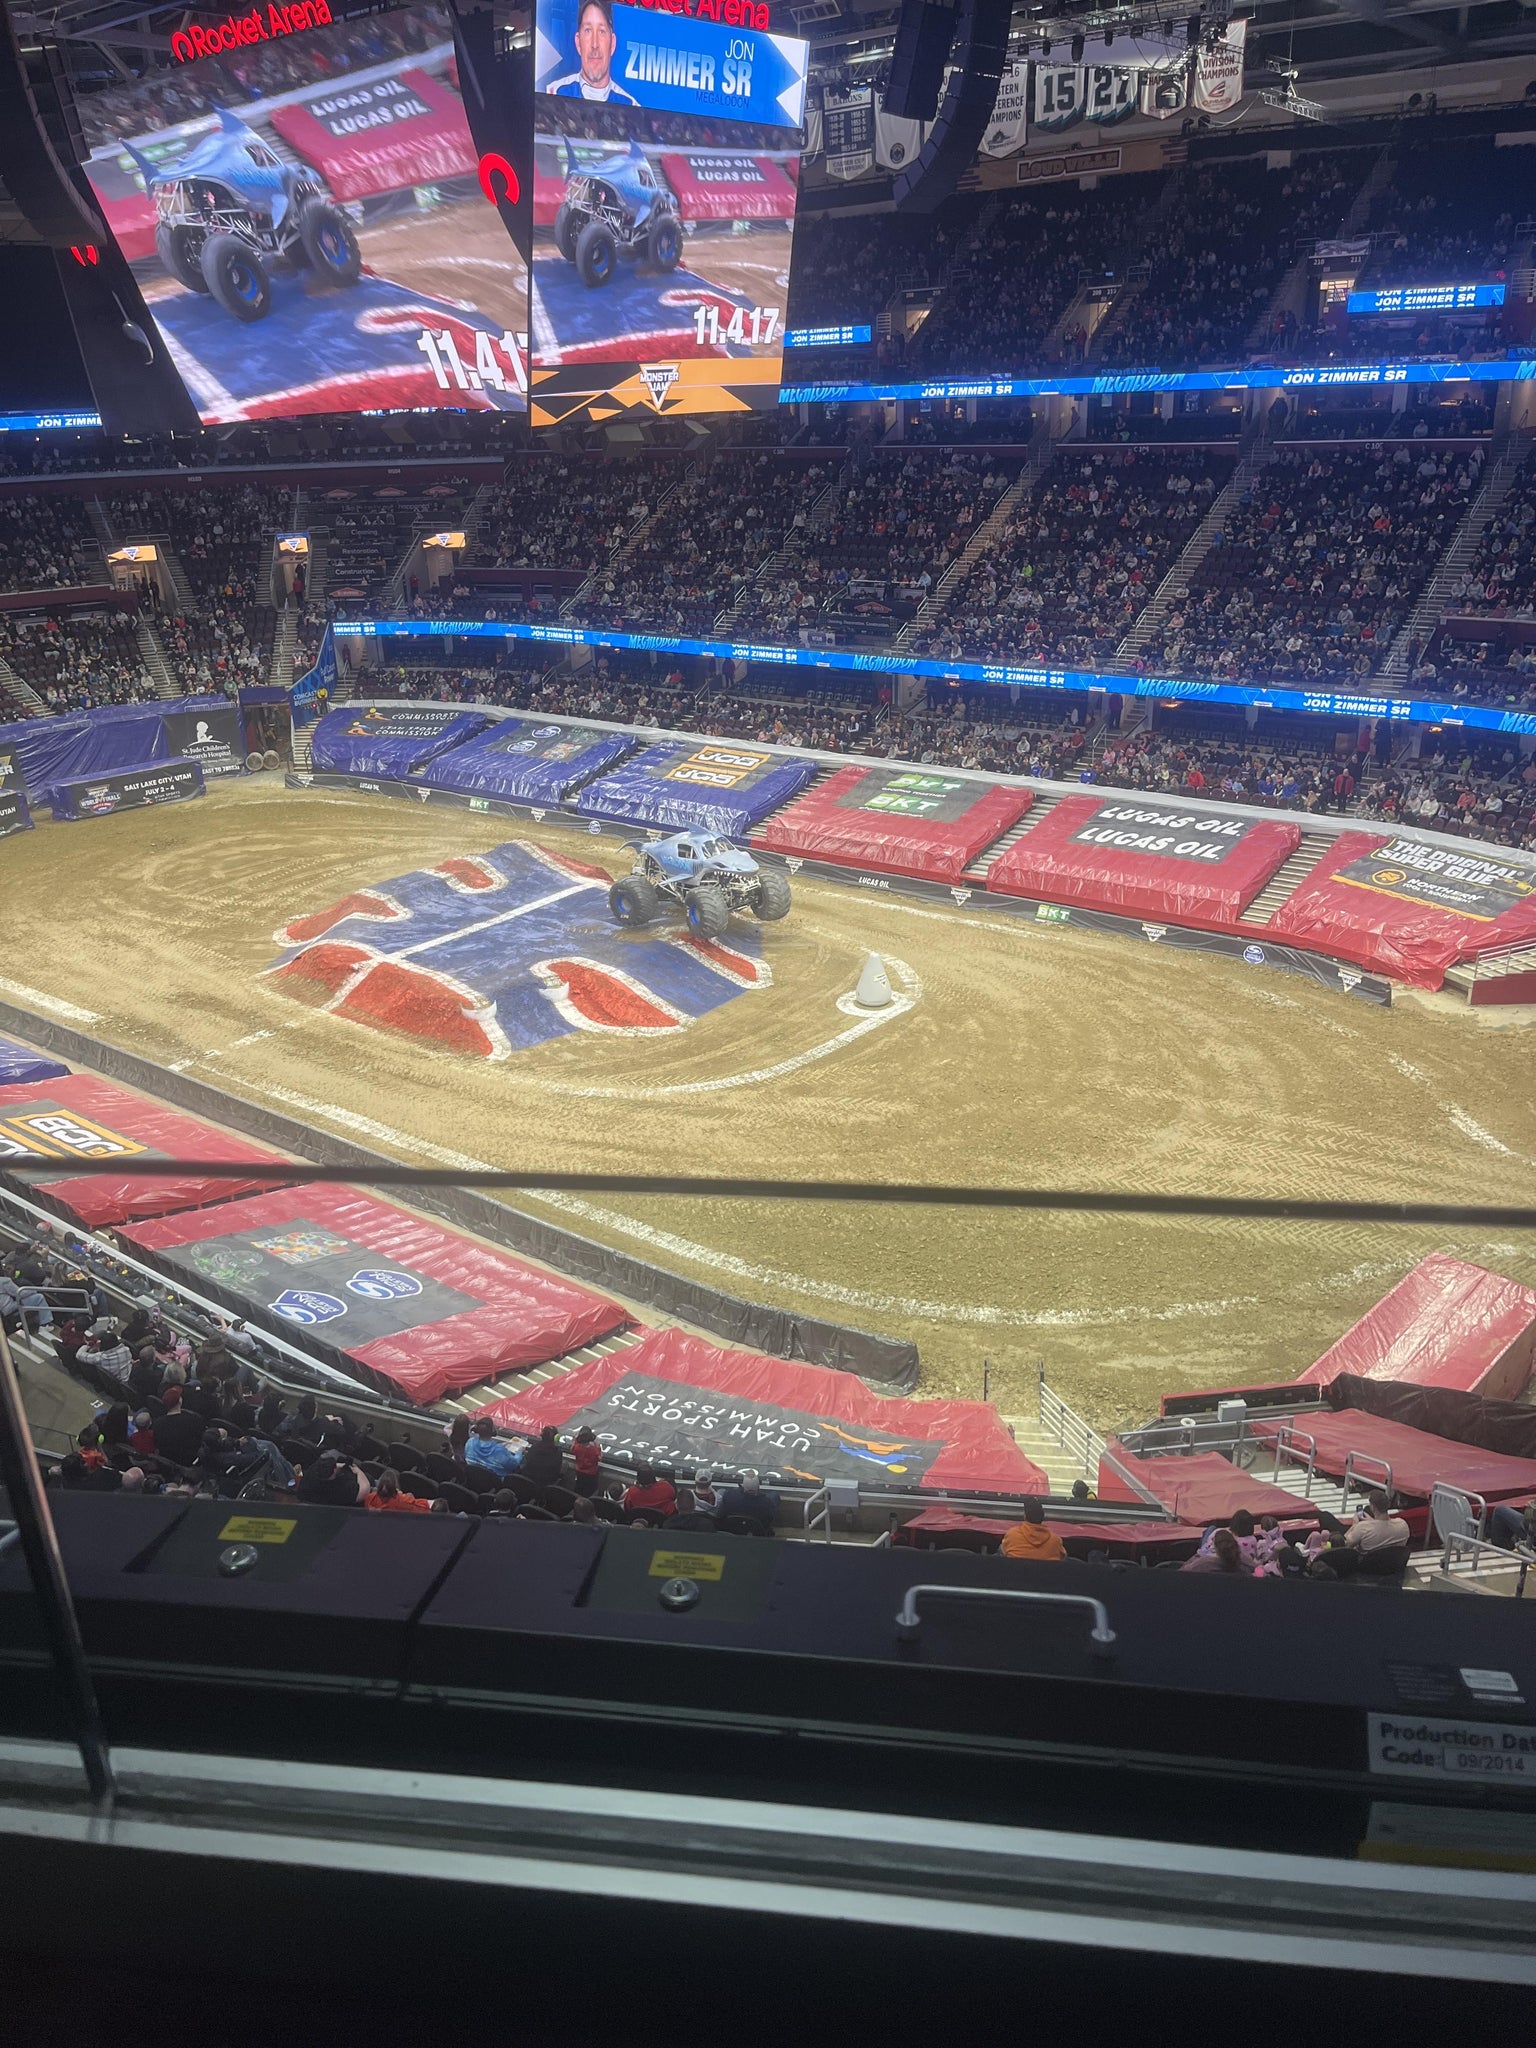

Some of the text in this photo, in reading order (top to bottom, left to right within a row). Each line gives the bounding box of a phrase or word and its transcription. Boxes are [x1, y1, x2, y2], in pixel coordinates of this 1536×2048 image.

[696, 0, 770, 31] Arena
[188, 0, 333, 58] Rocket Arena
[724, 38, 755, 62] JON
[624, 40, 753, 98] ZIMMER SR
[1203, 55, 1235, 68] DIVISION
[1197, 66, 1239, 80] CHAMPIONS
[695, 90, 750, 110] MEGALODON
[1043, 71, 1076, 114] 15
[310, 89, 373, 117] LUCAS
[329, 106, 394, 136] LUCAS
[990, 109, 1022, 124] AMPIONS
[689, 157, 732, 168] LUCAS
[696, 170, 745, 183] LUCAS
[1375, 293, 1476, 307] JON ZIMMER SR
[693, 306, 780, 345] 11.417
[791, 332, 853, 343] JON ZIMMER SR
[640, 371, 680, 384] MONSTER
[1282, 369, 1408, 385] JON ZIMMER SR
[649, 382, 670, 393] JAM
[921, 385, 1013, 397] JON ZIMMER SR
[36, 418, 62, 428] JON
[335, 568, 376, 576] Construction.
[333, 625, 376, 633] IMMER SR
[530, 630, 545, 638] JON
[545, 631, 573, 641] ZIMMER
[732, 649, 798, 661] JON ZIMMER SR
[982, 670, 1065, 685] JON ZIMMER SR
[1302, 698, 1411, 717] JON ZIMMER SR
[123, 784, 140, 792] SALT
[140, 780, 158, 789] LAKE
[174, 772, 192, 782] UTAH
[674, 769, 737, 785] JCB
[145, 788, 160, 796] JULY
[470, 798, 488, 809] BKT
[867, 795, 941, 811] BKT
[0, 806, 16, 817] UTAH
[1097, 806, 1196, 828] LUCAS
[1076, 827, 1177, 851] LUCAS
[1393, 840, 1432, 858] THE
[1376, 849, 1500, 886] SUPER GLUE
[858, 876, 890, 889] LUCAS OIL
[1406, 878, 1482, 901] NORTHERN
[1037, 906, 1070, 921] BKT
[28, 1116, 125, 1151] JCB
[619, 1385, 822, 1440] COMMISSION
[606, 1393, 812, 1454] UTAH SPORTS
[1380, 1721, 1494, 1748] Production
[1457, 1754, 1525, 1771] 09/2014
